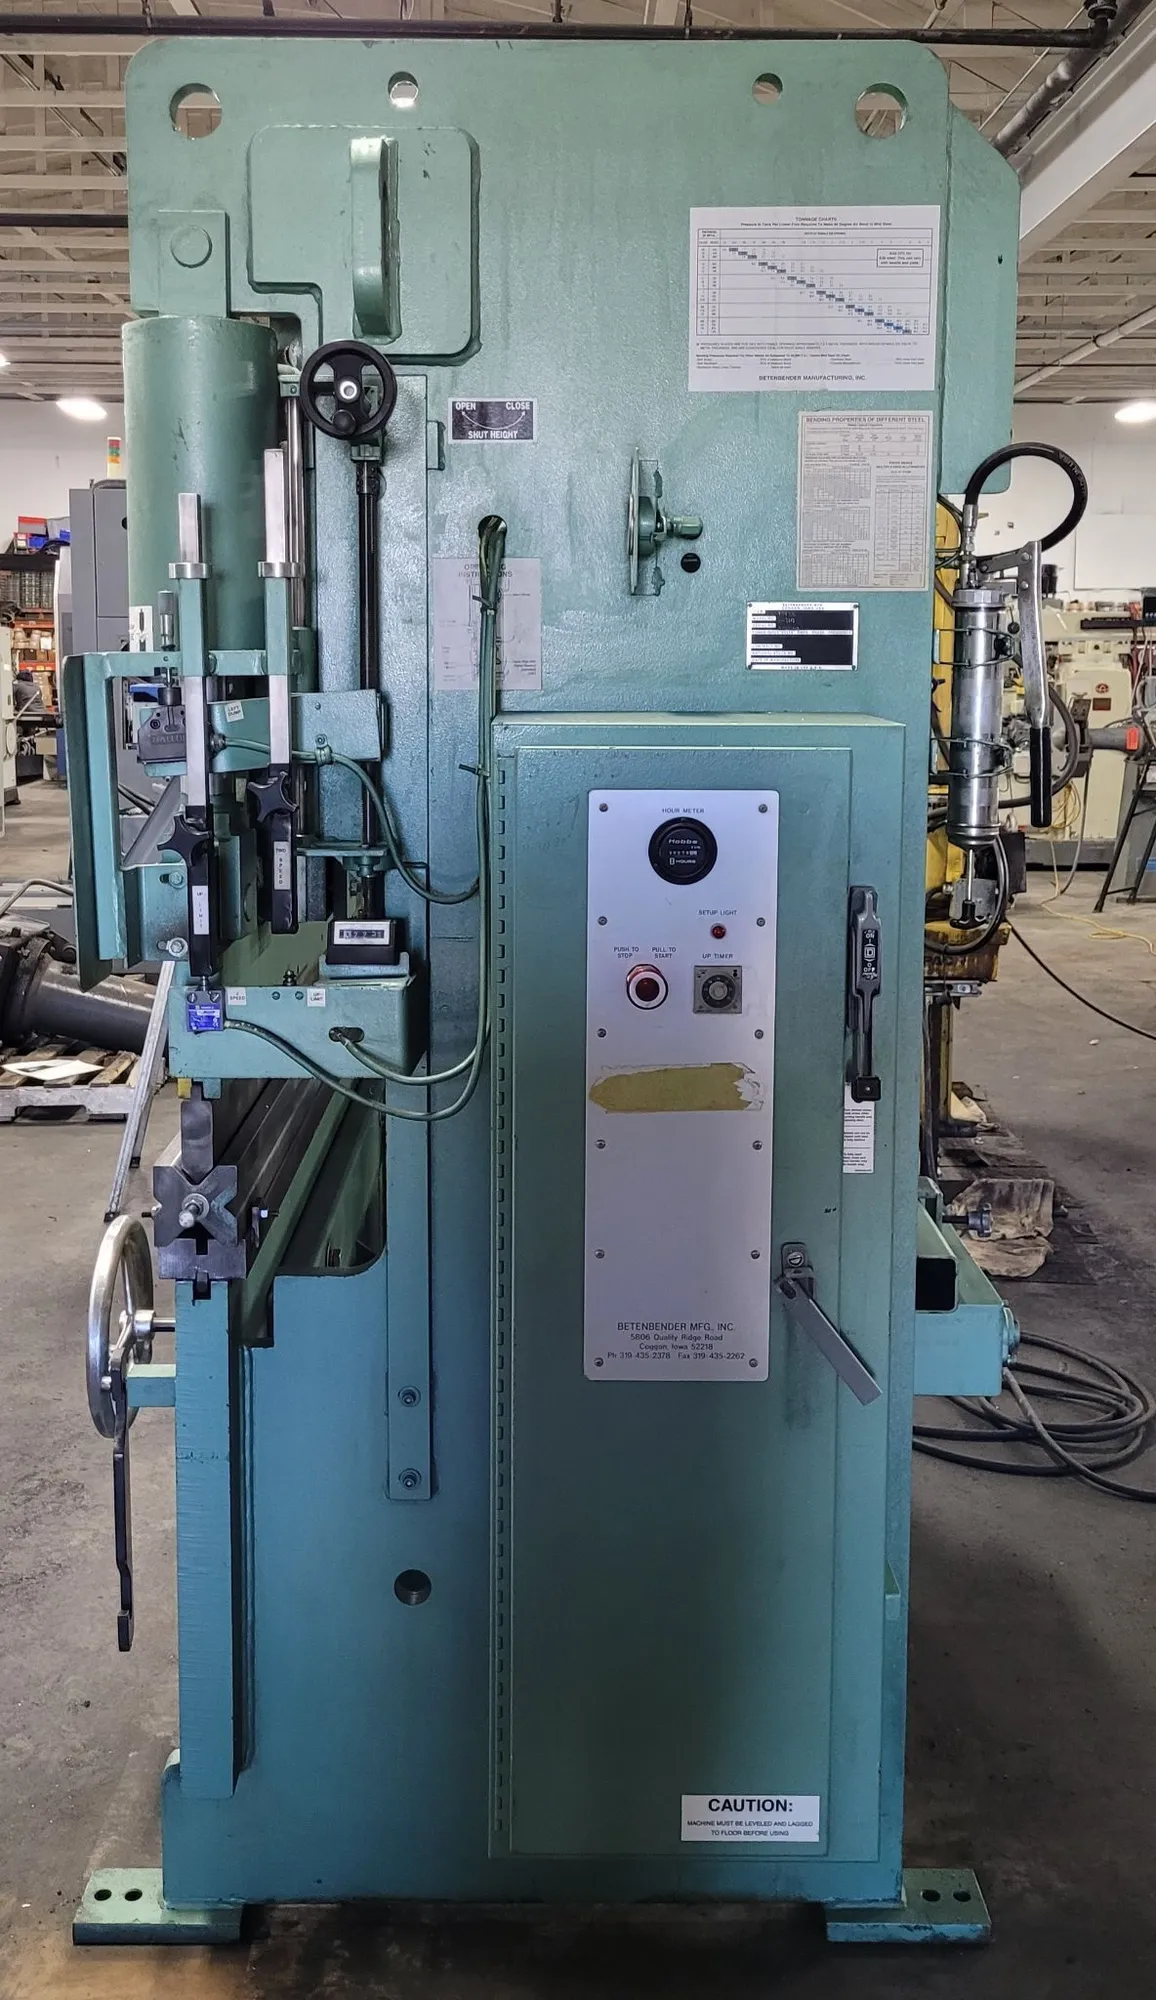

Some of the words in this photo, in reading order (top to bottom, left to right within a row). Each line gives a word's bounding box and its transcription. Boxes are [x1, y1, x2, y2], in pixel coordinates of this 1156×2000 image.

[455, 402, 476, 410] OPEN
[506, 402, 530, 410] CLOSE
[468, 430, 488, 439] SHUT
[490, 430, 518, 439] HEIGHT
[618, 1322, 687, 1331] BETENBENDER
[708, 1798, 793, 1812] CAUTION:
